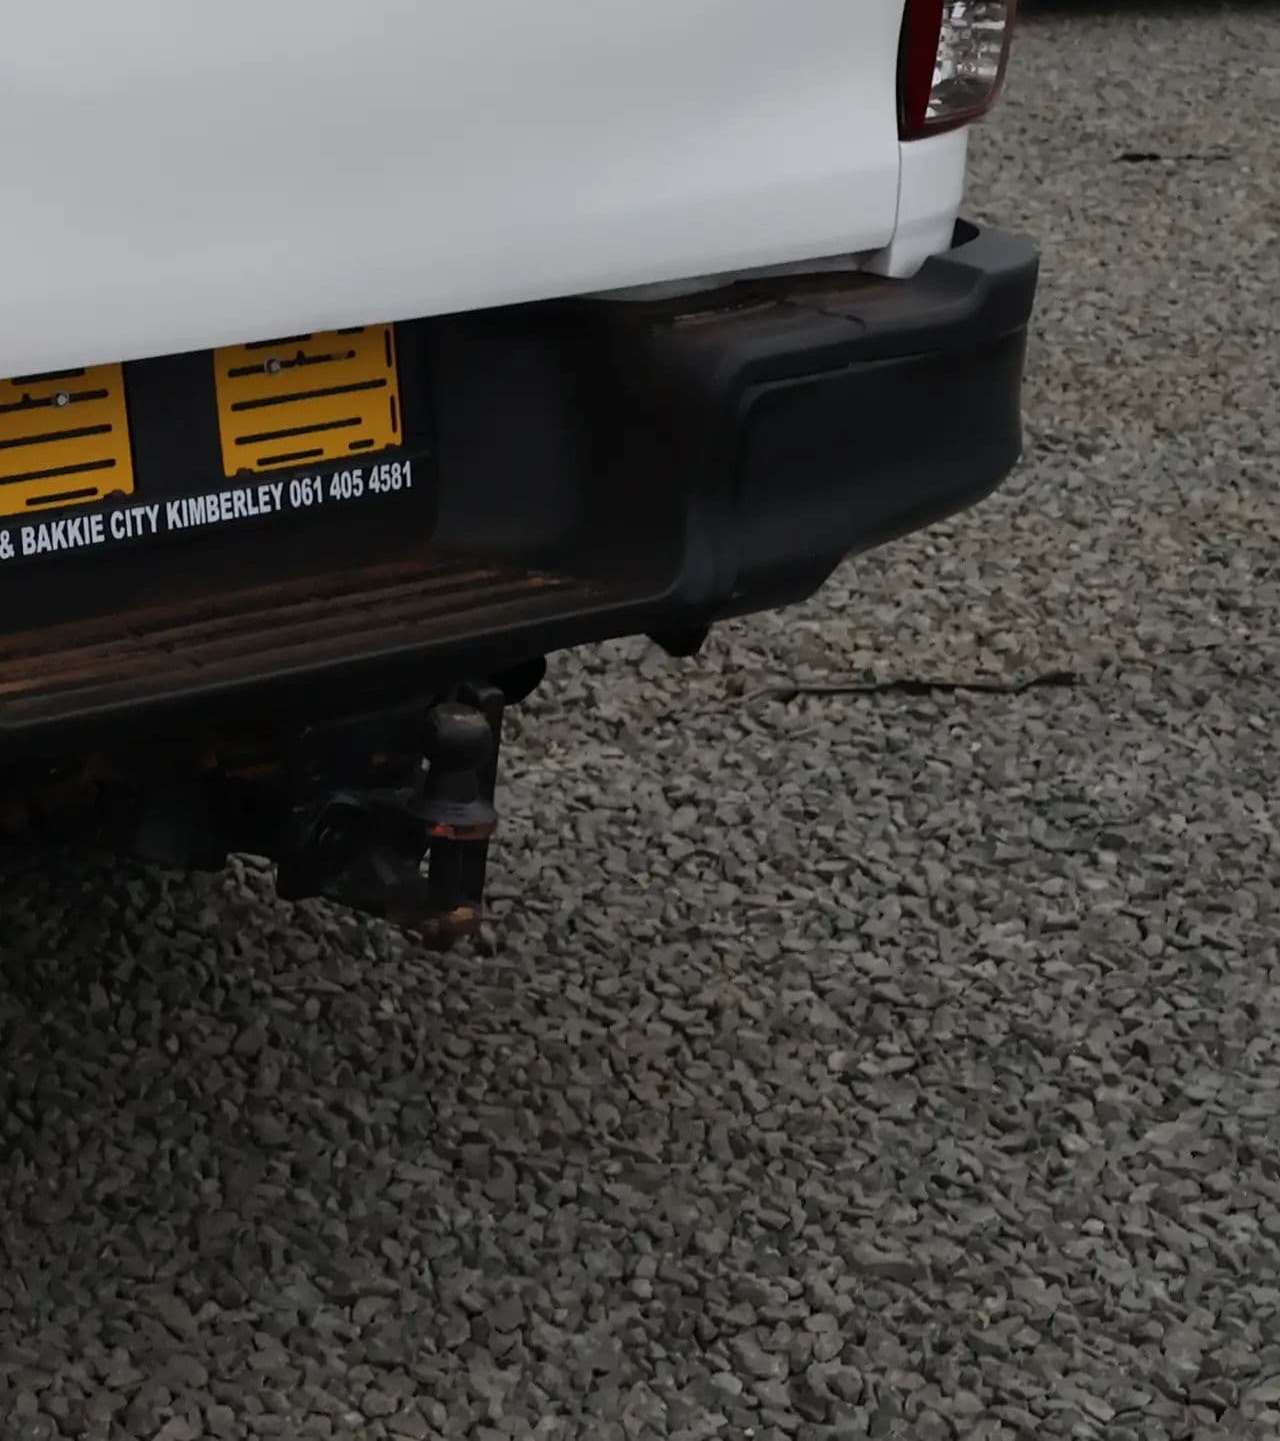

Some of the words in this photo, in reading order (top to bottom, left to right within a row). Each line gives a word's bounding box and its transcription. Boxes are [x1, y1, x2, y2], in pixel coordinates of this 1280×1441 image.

[21, 515, 105, 556] BAKKIE
[110, 504, 159, 540] CITY
[166, 482, 284, 529] KIMBERLEY
[289, 475, 323, 507] 061
[329, 469, 364, 500] 405
[368, 460, 412, 493] 4581
